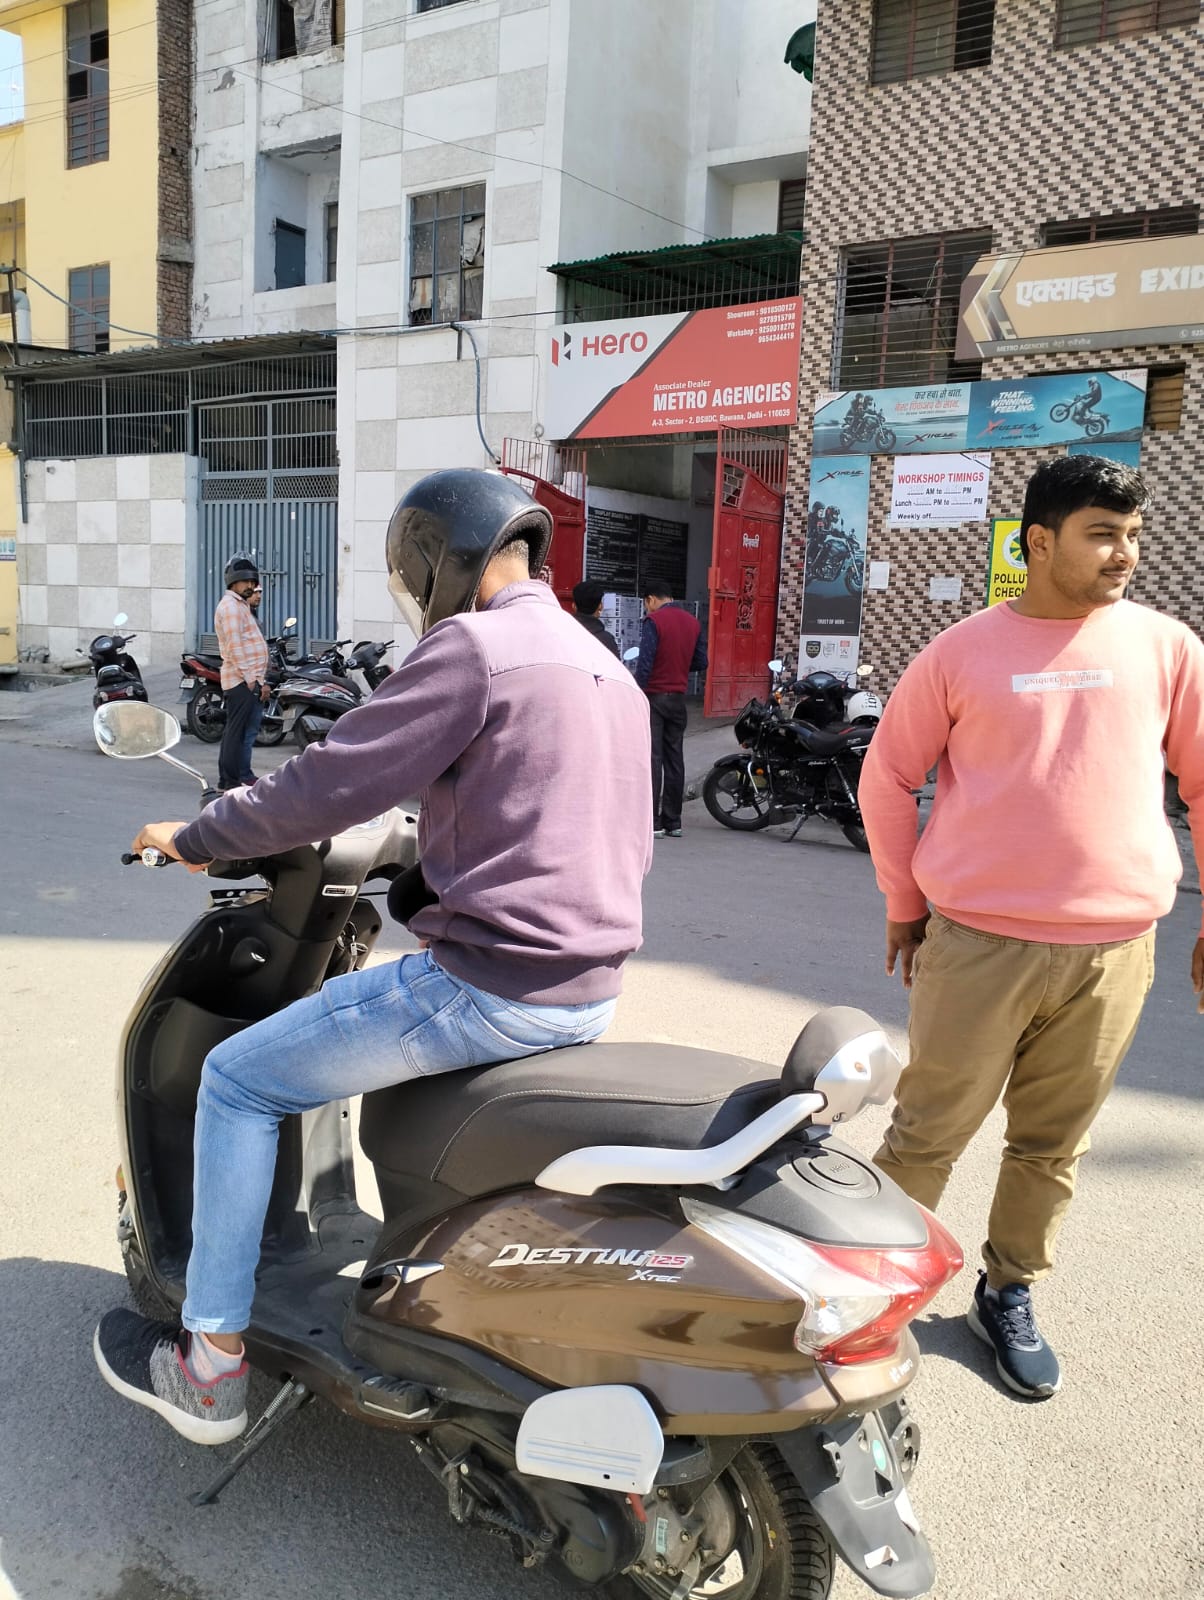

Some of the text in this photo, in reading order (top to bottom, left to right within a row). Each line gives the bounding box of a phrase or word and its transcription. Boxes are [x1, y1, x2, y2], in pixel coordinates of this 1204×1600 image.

[582, 331, 648, 357] Hero
[654, 379, 712, 391] Associate Dealer
[653, 381, 792, 412] METRO AGENCIES
[999, 390, 1025, 400] THAT
[991, 396, 1033, 408] WINNING
[898, 471, 985, 485] WORKSHOP TIMINGS
[925, 487, 935, 495] AM
[936, 487, 943, 495] to
[895, 499, 912, 507] Lunch
[933, 498, 943, 506] PM
[973, 497, 983, 505] PM
[897, 513, 920, 521] Weekly
[994, 573, 1027, 584] POLLU
[652, 1254, 687, 1266] 125
